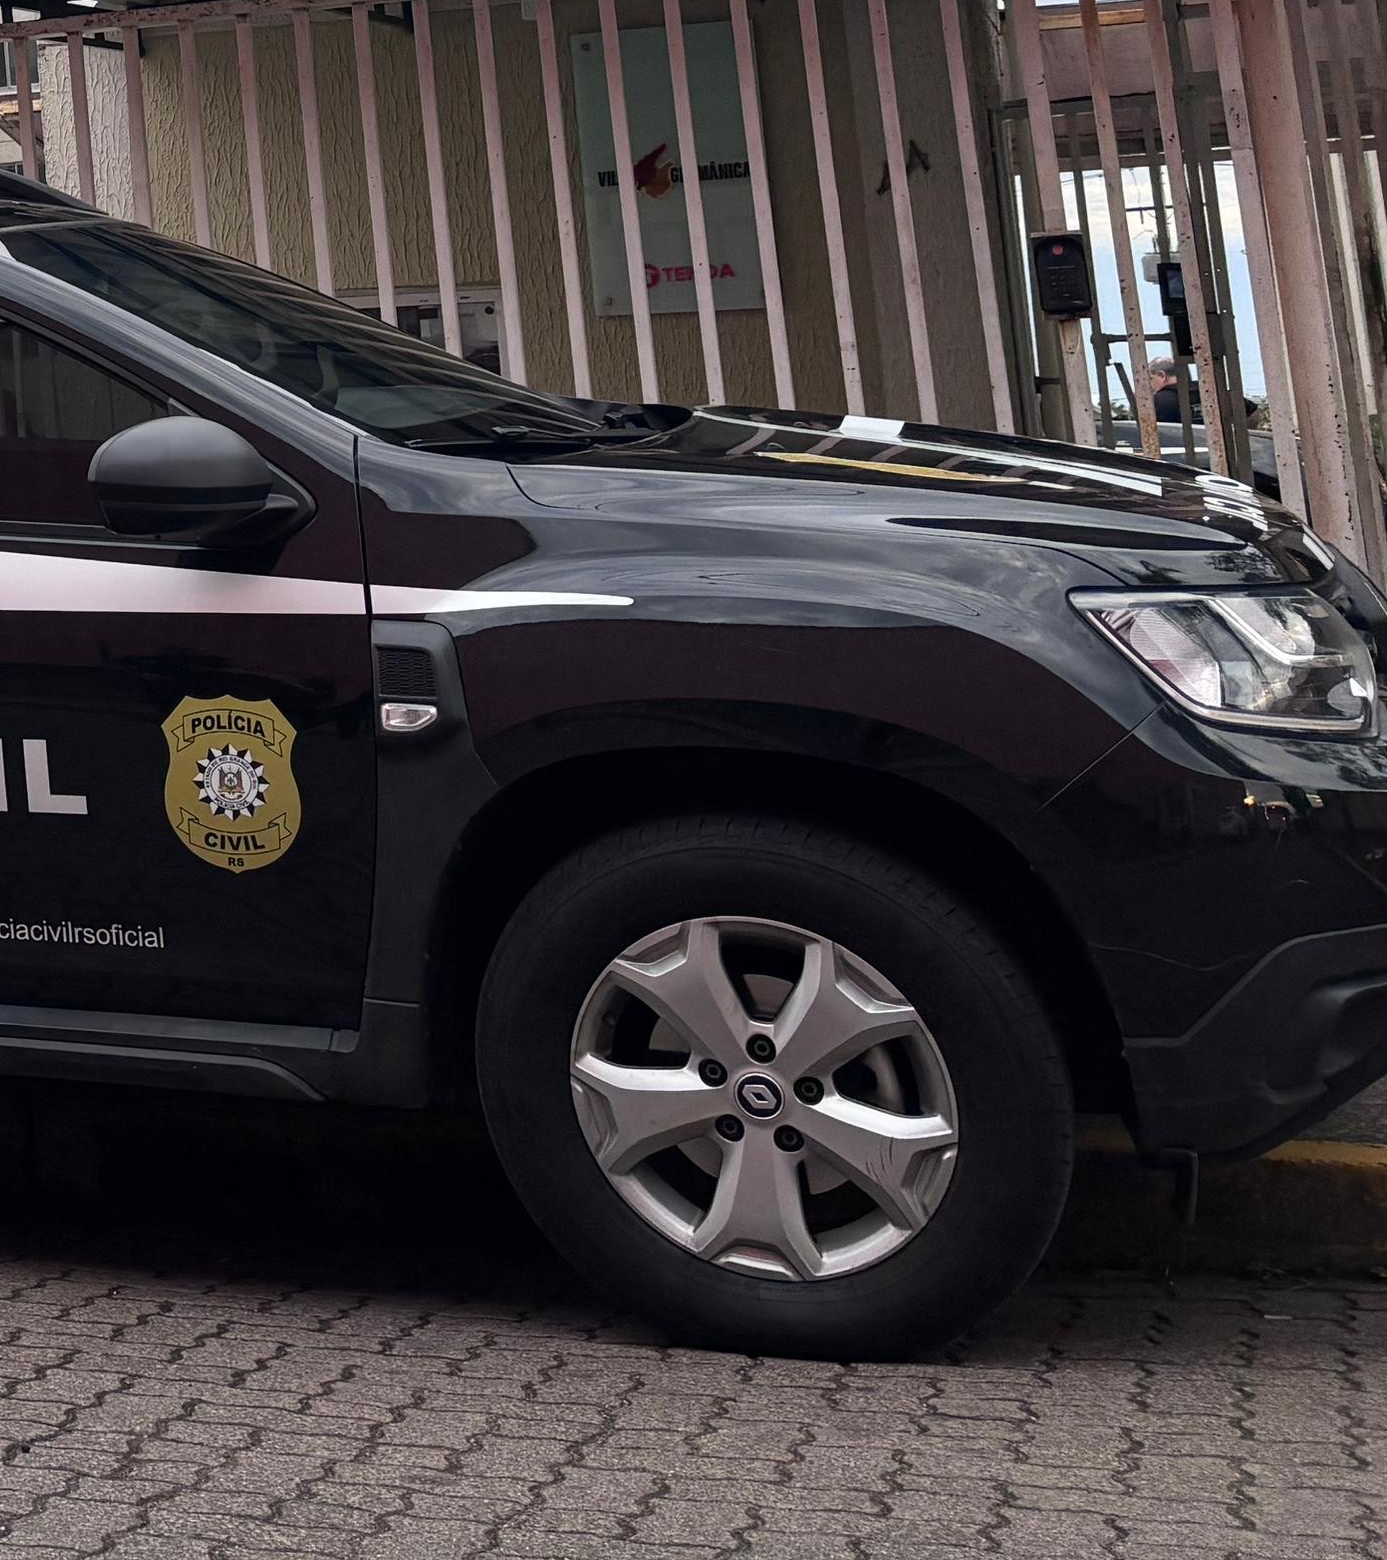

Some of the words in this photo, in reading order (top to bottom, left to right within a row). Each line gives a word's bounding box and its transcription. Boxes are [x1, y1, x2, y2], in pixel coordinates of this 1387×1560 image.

[191, 711, 266, 737] POLÍCIA
[204, 832, 266, 851] CIVIL
[228, 857, 244, 867] RS
